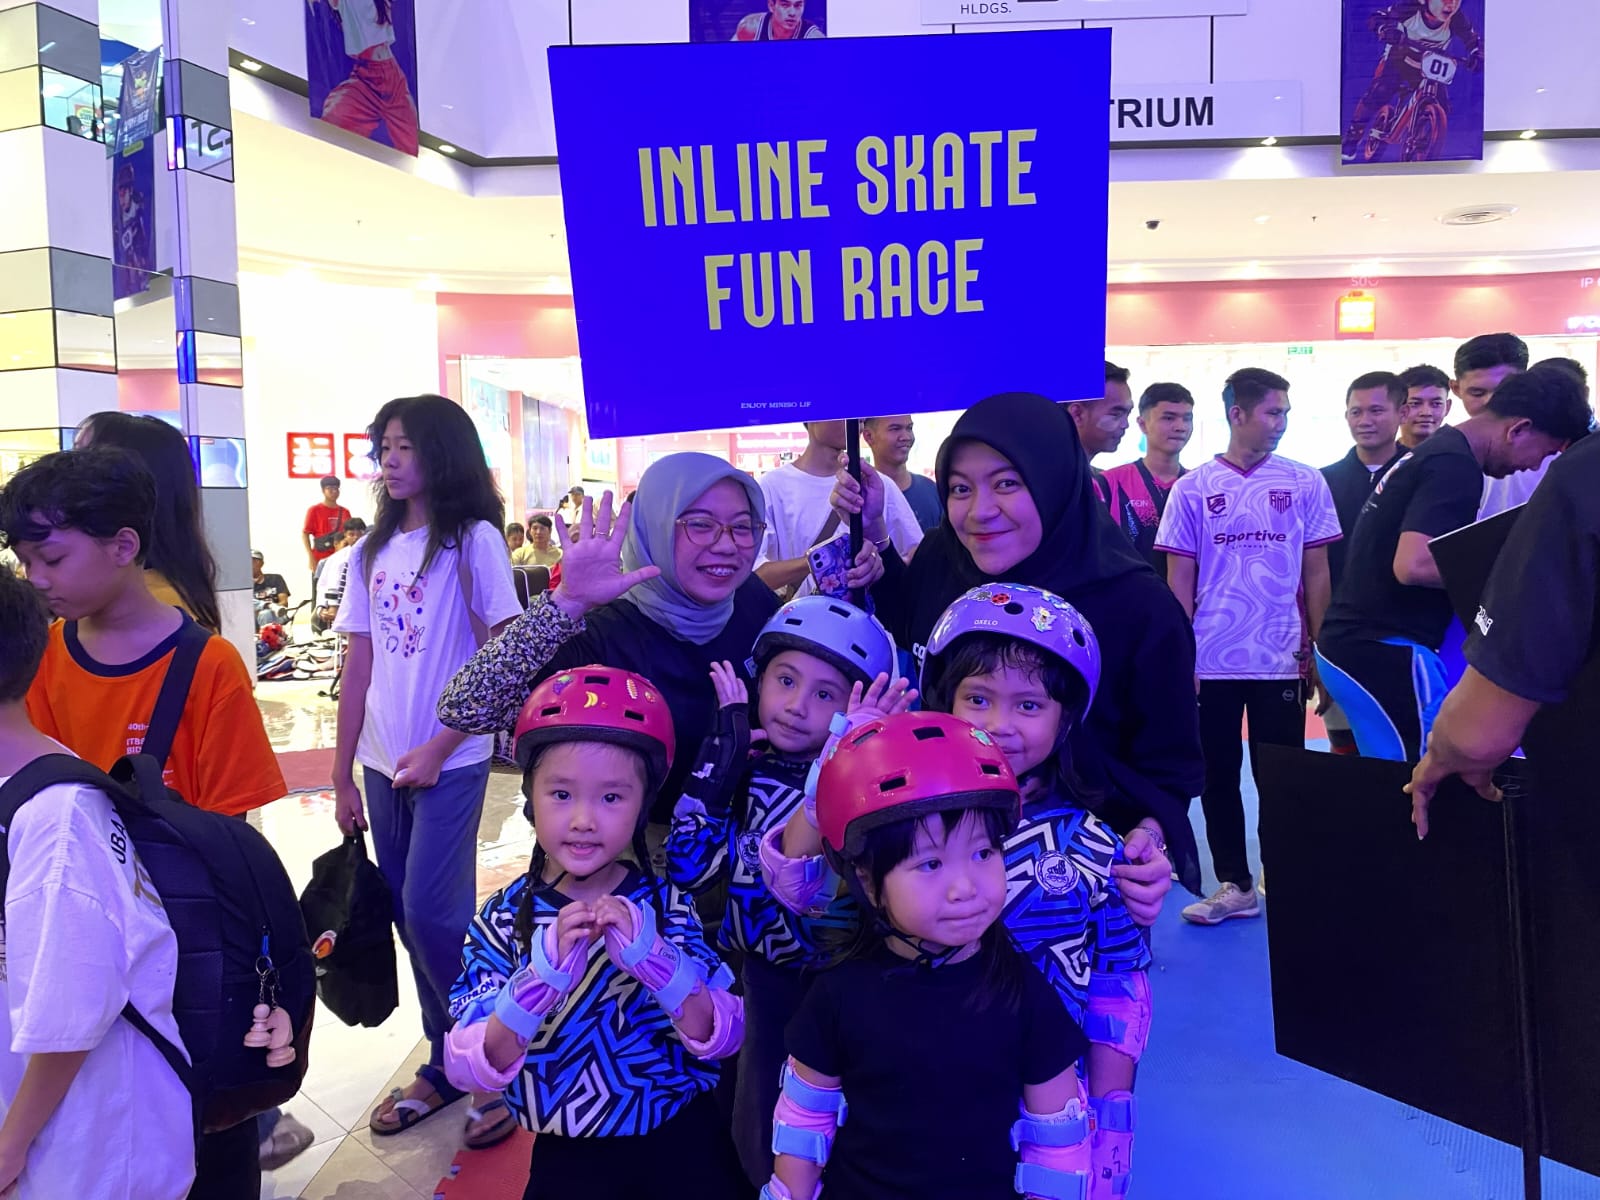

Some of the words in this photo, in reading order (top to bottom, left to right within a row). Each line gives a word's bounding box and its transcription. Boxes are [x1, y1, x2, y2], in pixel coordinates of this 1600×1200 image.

[961, 2, 1012, 15] HLDGS.
[1430, 59, 1449, 77] 01
[1110, 96, 1214, 128] RIUM
[638, 139, 830, 227] INLINE
[855, 128, 1038, 215] SKATE
[704, 249, 814, 331] FUN
[841, 238, 984, 321] RACE
[1213, 529, 1287, 546] Sportive
